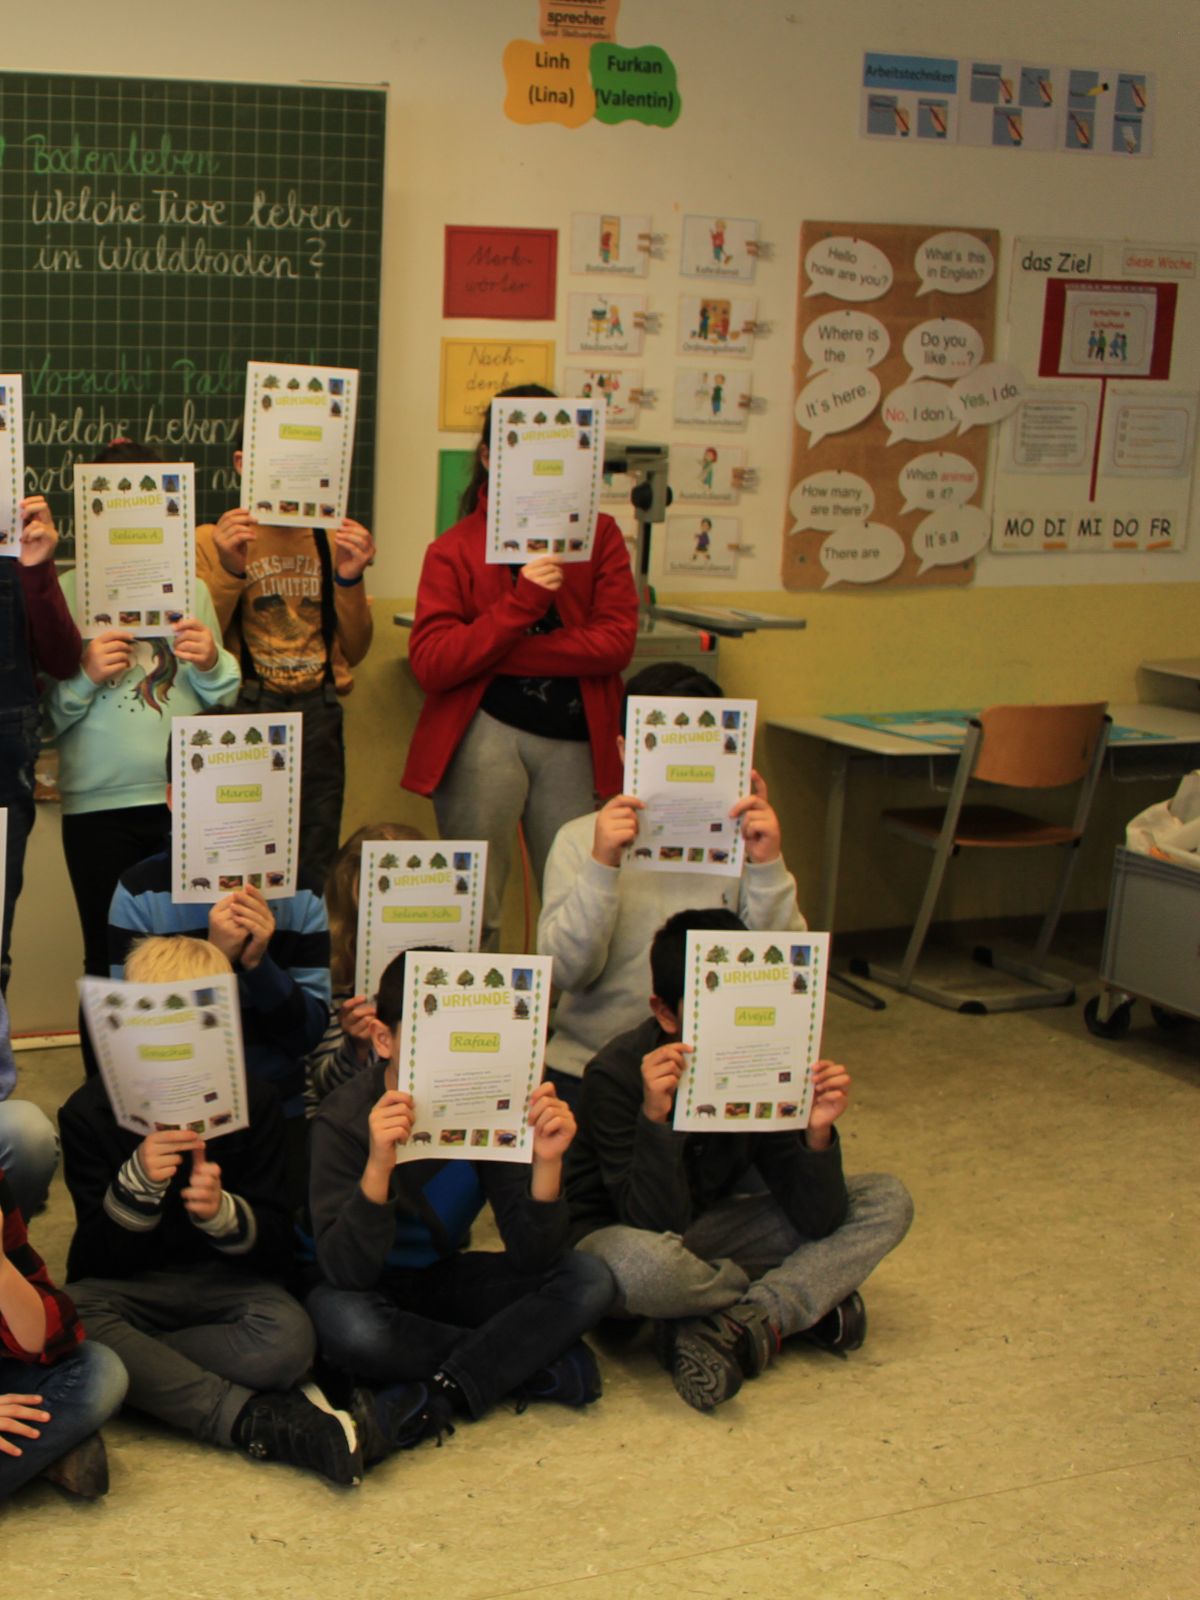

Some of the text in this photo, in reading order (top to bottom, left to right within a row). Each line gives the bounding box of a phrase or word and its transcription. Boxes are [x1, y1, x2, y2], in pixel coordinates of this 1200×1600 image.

[547, 10, 606, 27] sprecher
[535, 50, 570, 69] Linh
[607, 55, 663, 76] Furkan
[528, 87, 575, 107] (Lina)
[32, 186, 352, 230] Welche Tiere leben
[98, 236, 299, 280] Waldboden
[829, 246, 858, 264] Hello
[1021, 250, 1091, 274] das Ziel
[811, 262, 888, 287] how are you?
[927, 266, 985, 283] in English?
[818, 325, 879, 342] Where is
[920, 331, 967, 351] Do you
[824, 348, 846, 362] the
[924, 349, 947, 366] like
[960, 390, 990, 410] Yes,
[27, 407, 131, 445] Welche
[906, 467, 938, 481] Which
[801, 484, 863, 502] How many
[811, 501, 869, 518] are there?
[1005, 518, 1171, 537] MO DI MI DO FR
[823, 546, 880, 561] There are
[441, 992, 510, 1008] URKUNDE
